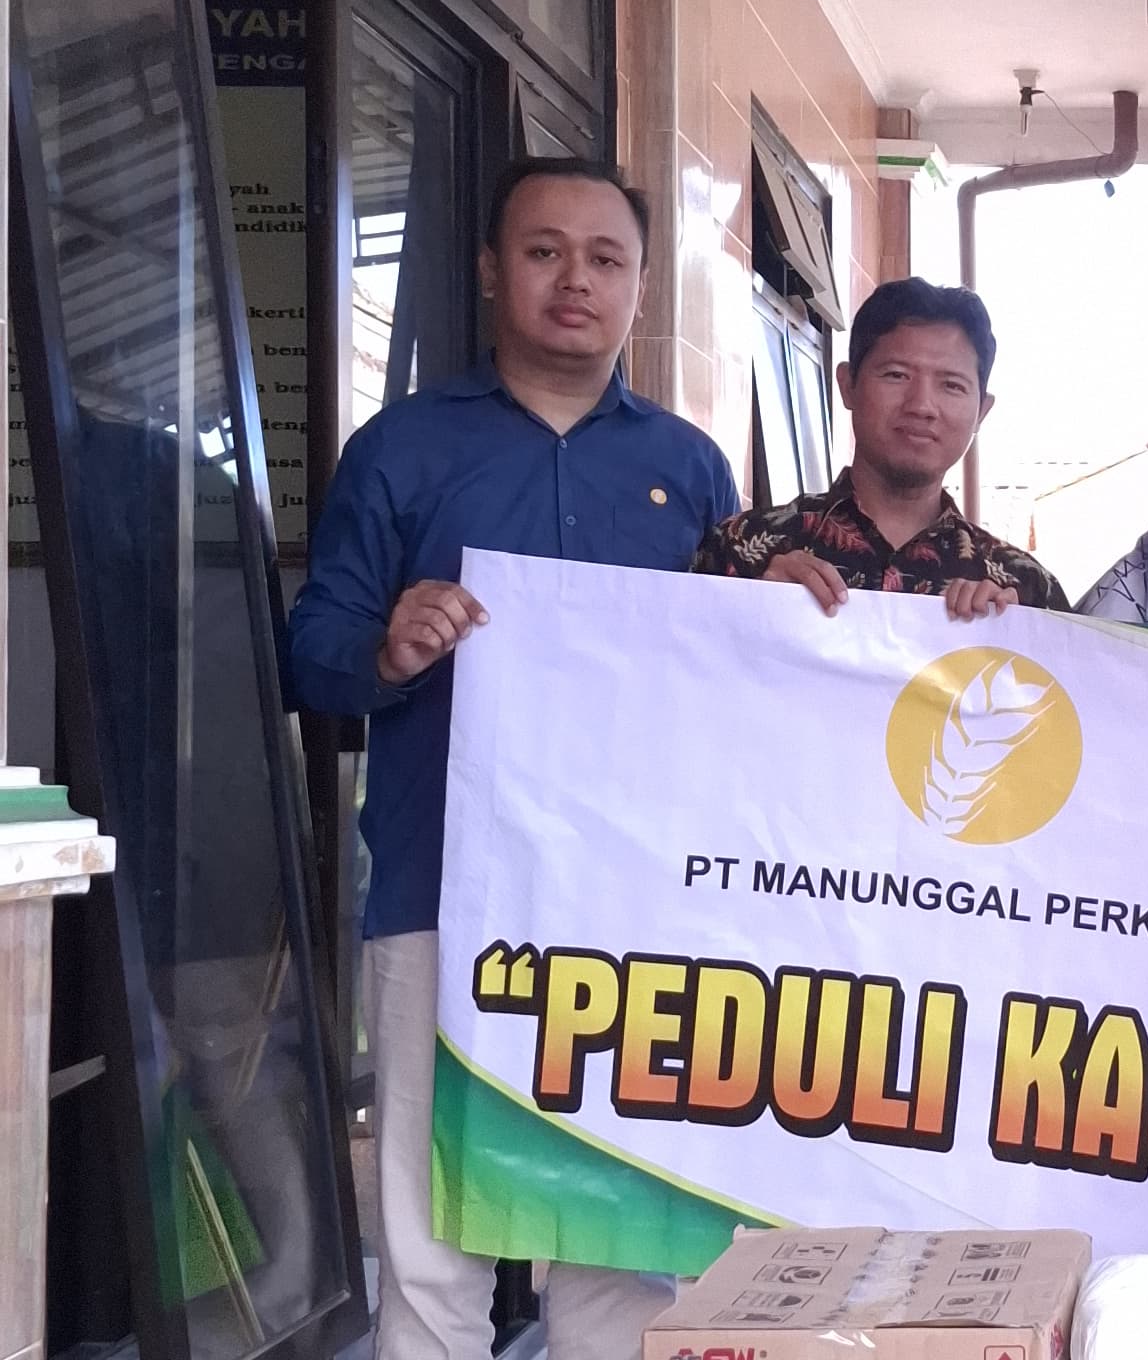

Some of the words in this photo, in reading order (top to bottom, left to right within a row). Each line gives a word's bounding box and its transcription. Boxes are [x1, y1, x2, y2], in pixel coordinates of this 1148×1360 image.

[214, 53, 305, 71] ENG
[246, 202, 305, 214] anak
[684, 855, 739, 890] PT
[752, 860, 1031, 923] MANUNGGAL
